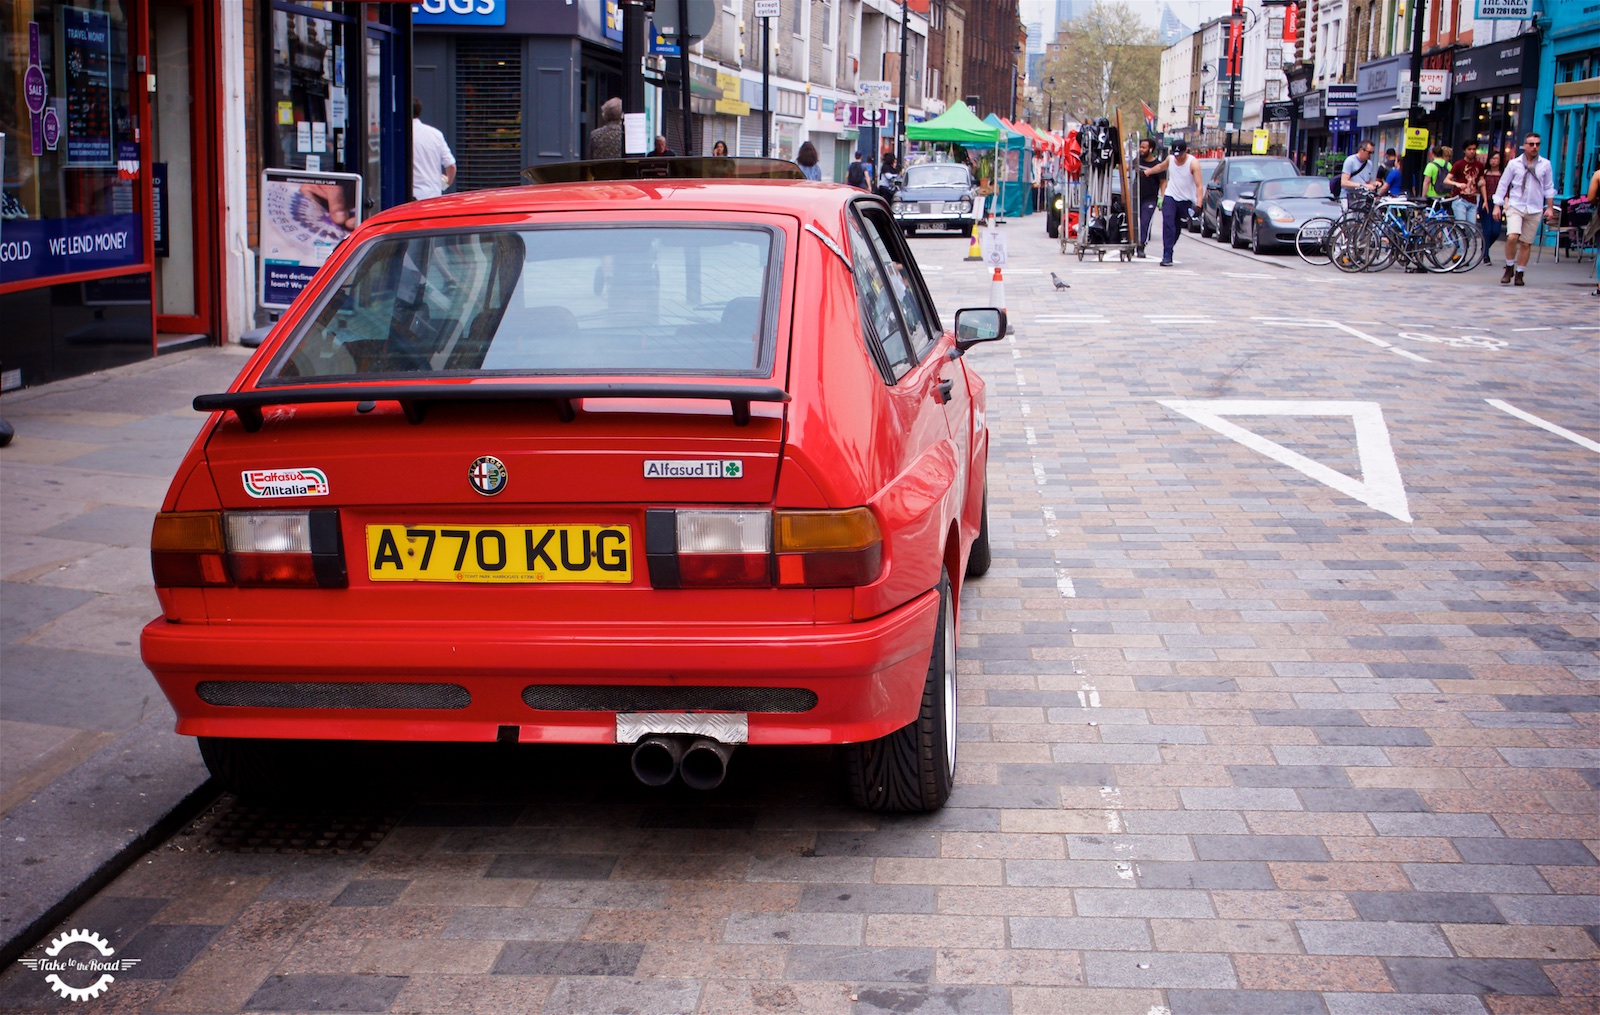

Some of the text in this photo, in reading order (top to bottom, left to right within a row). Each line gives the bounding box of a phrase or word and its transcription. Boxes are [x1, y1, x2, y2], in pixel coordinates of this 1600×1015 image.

[412, 0, 496, 15] GGS
[1482, 7, 1495, 15] 020
[67, 28, 105, 43] TRAVEL MONEY
[28, 84, 42, 96] SALE
[0, 232, 128, 262] GOLD WE LEND MONEY
[270, 271, 288, 279] Been
[270, 280, 290, 289] loan?
[647, 463, 718, 476] Alfasud Ti
[262, 485, 307, 496] Alitalia
[374, 529, 627, 572] A770 KUG
